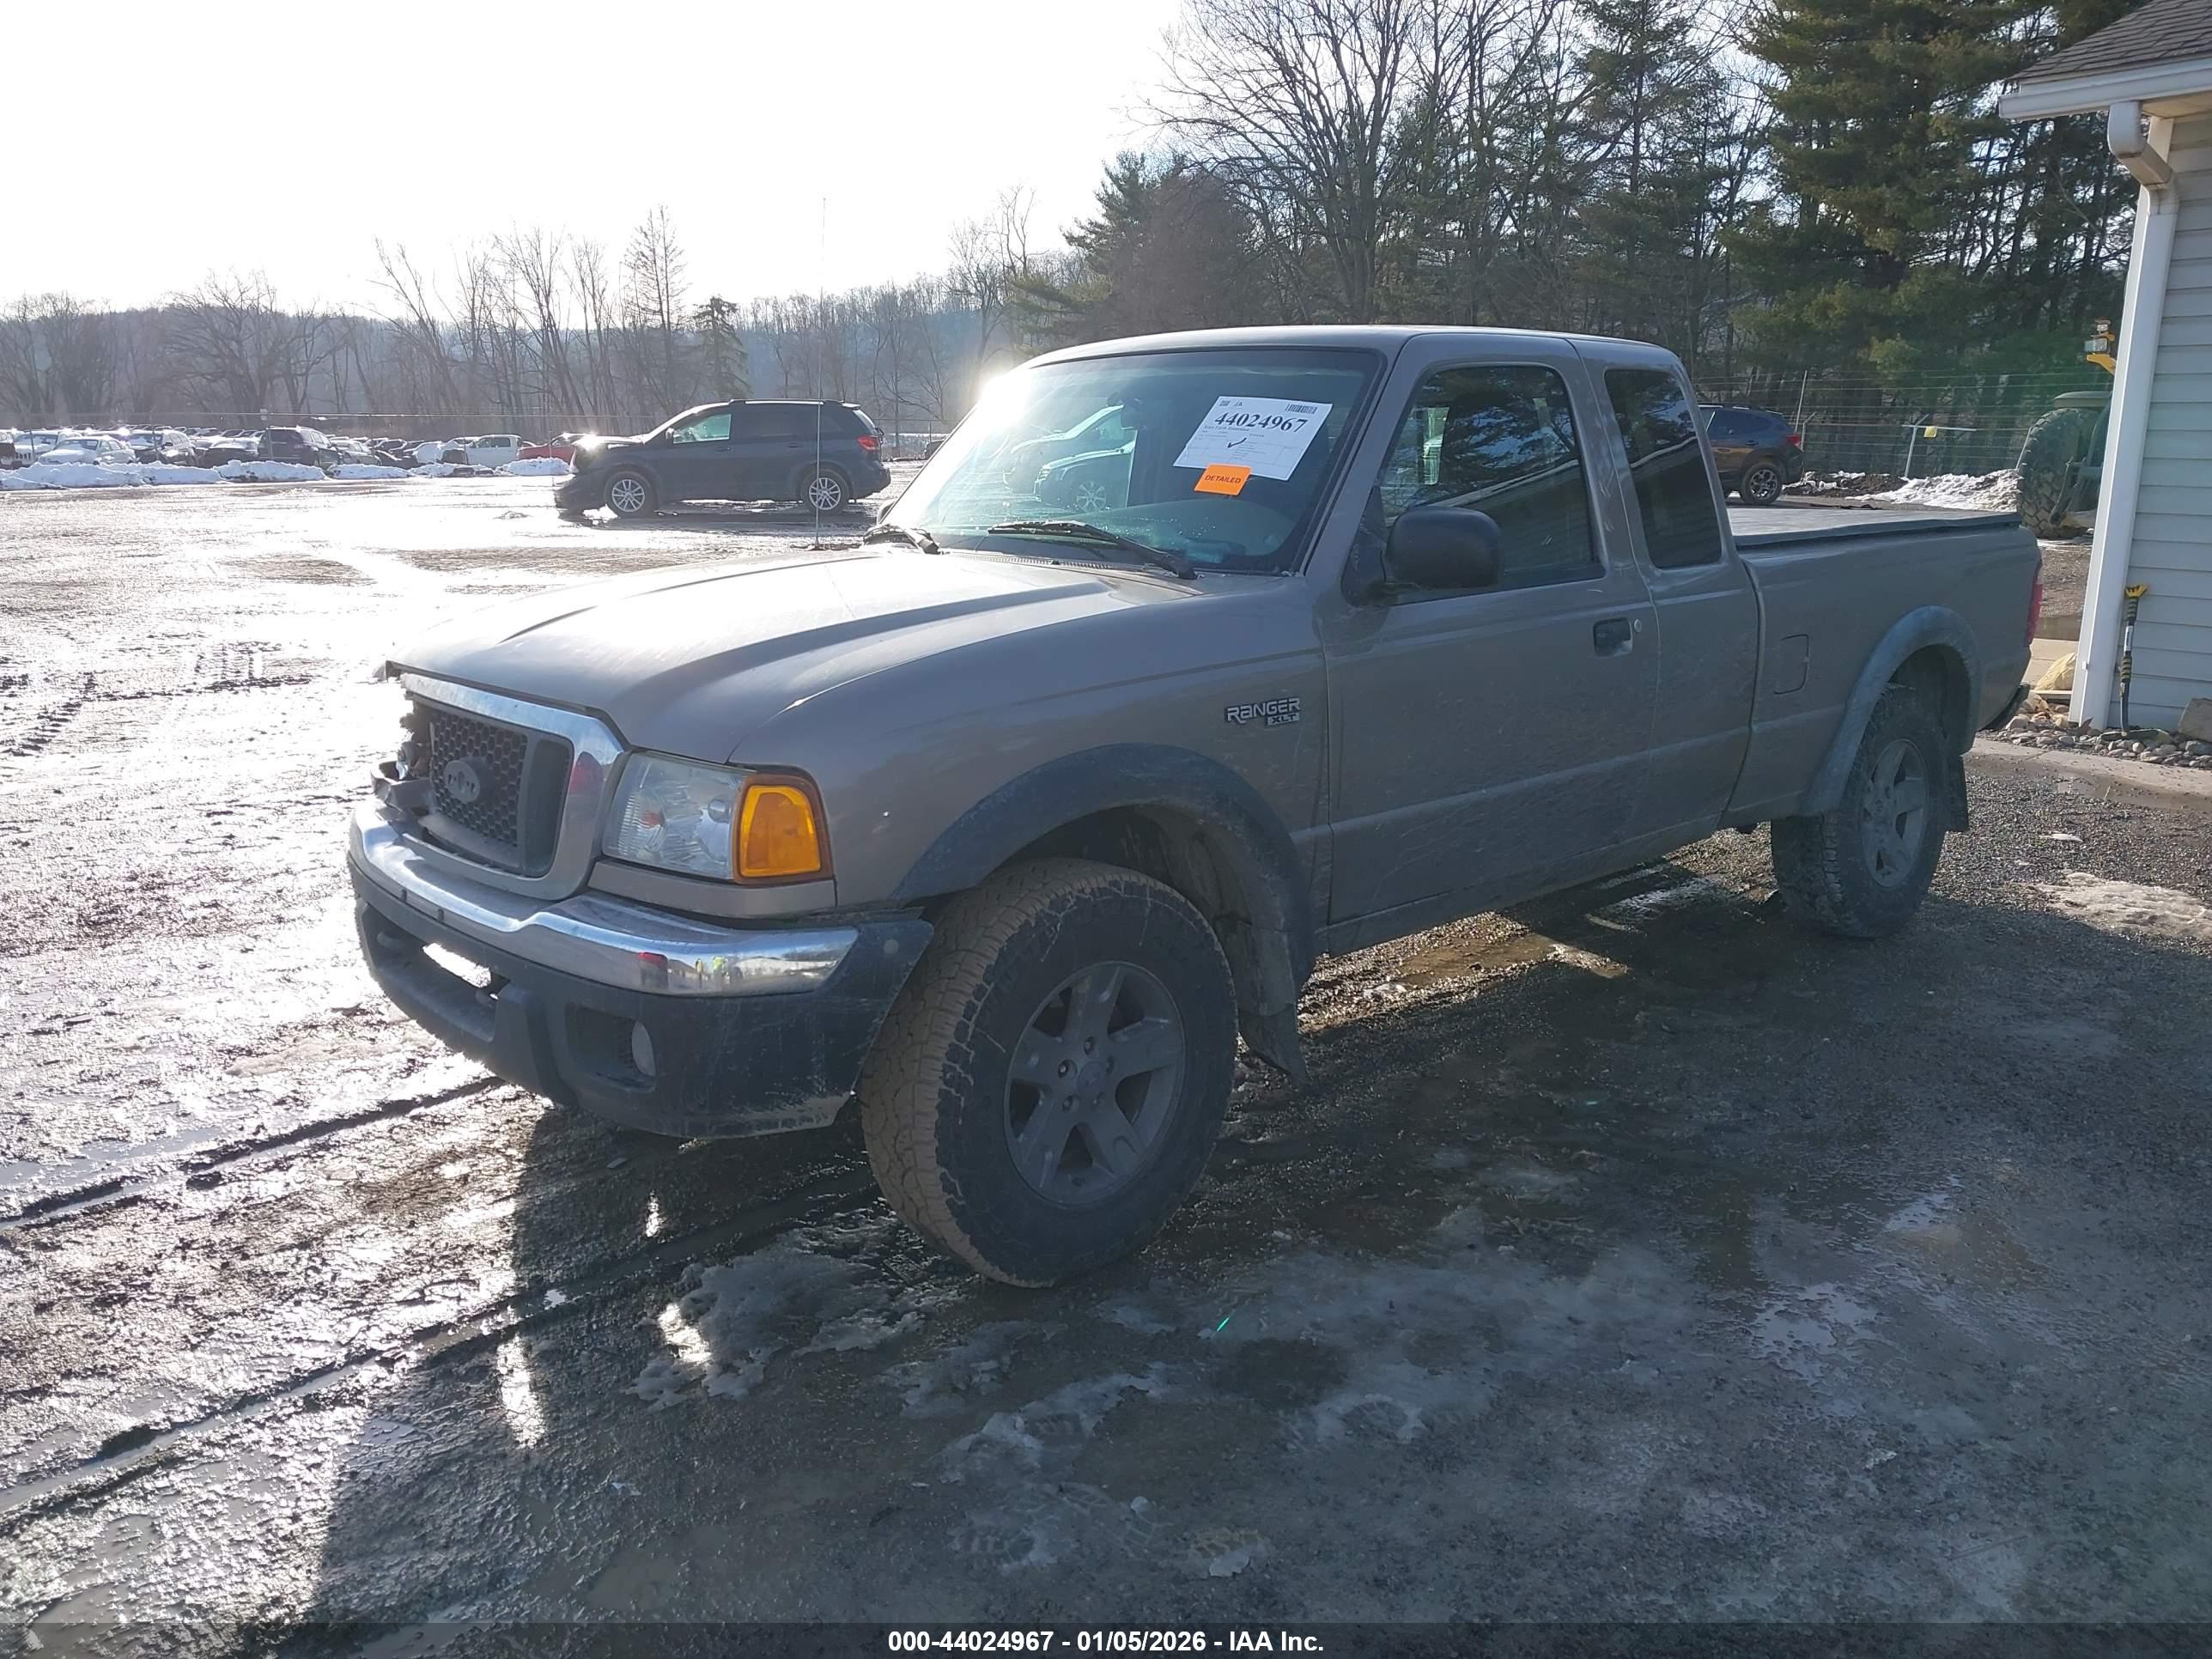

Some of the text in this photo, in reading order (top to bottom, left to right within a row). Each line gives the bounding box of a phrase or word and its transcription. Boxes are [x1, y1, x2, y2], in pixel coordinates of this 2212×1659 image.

[1214, 412, 1308, 433] 44024967
[1204, 475, 1242, 484] DETAILED
[1227, 697, 1300, 723] RANGER
